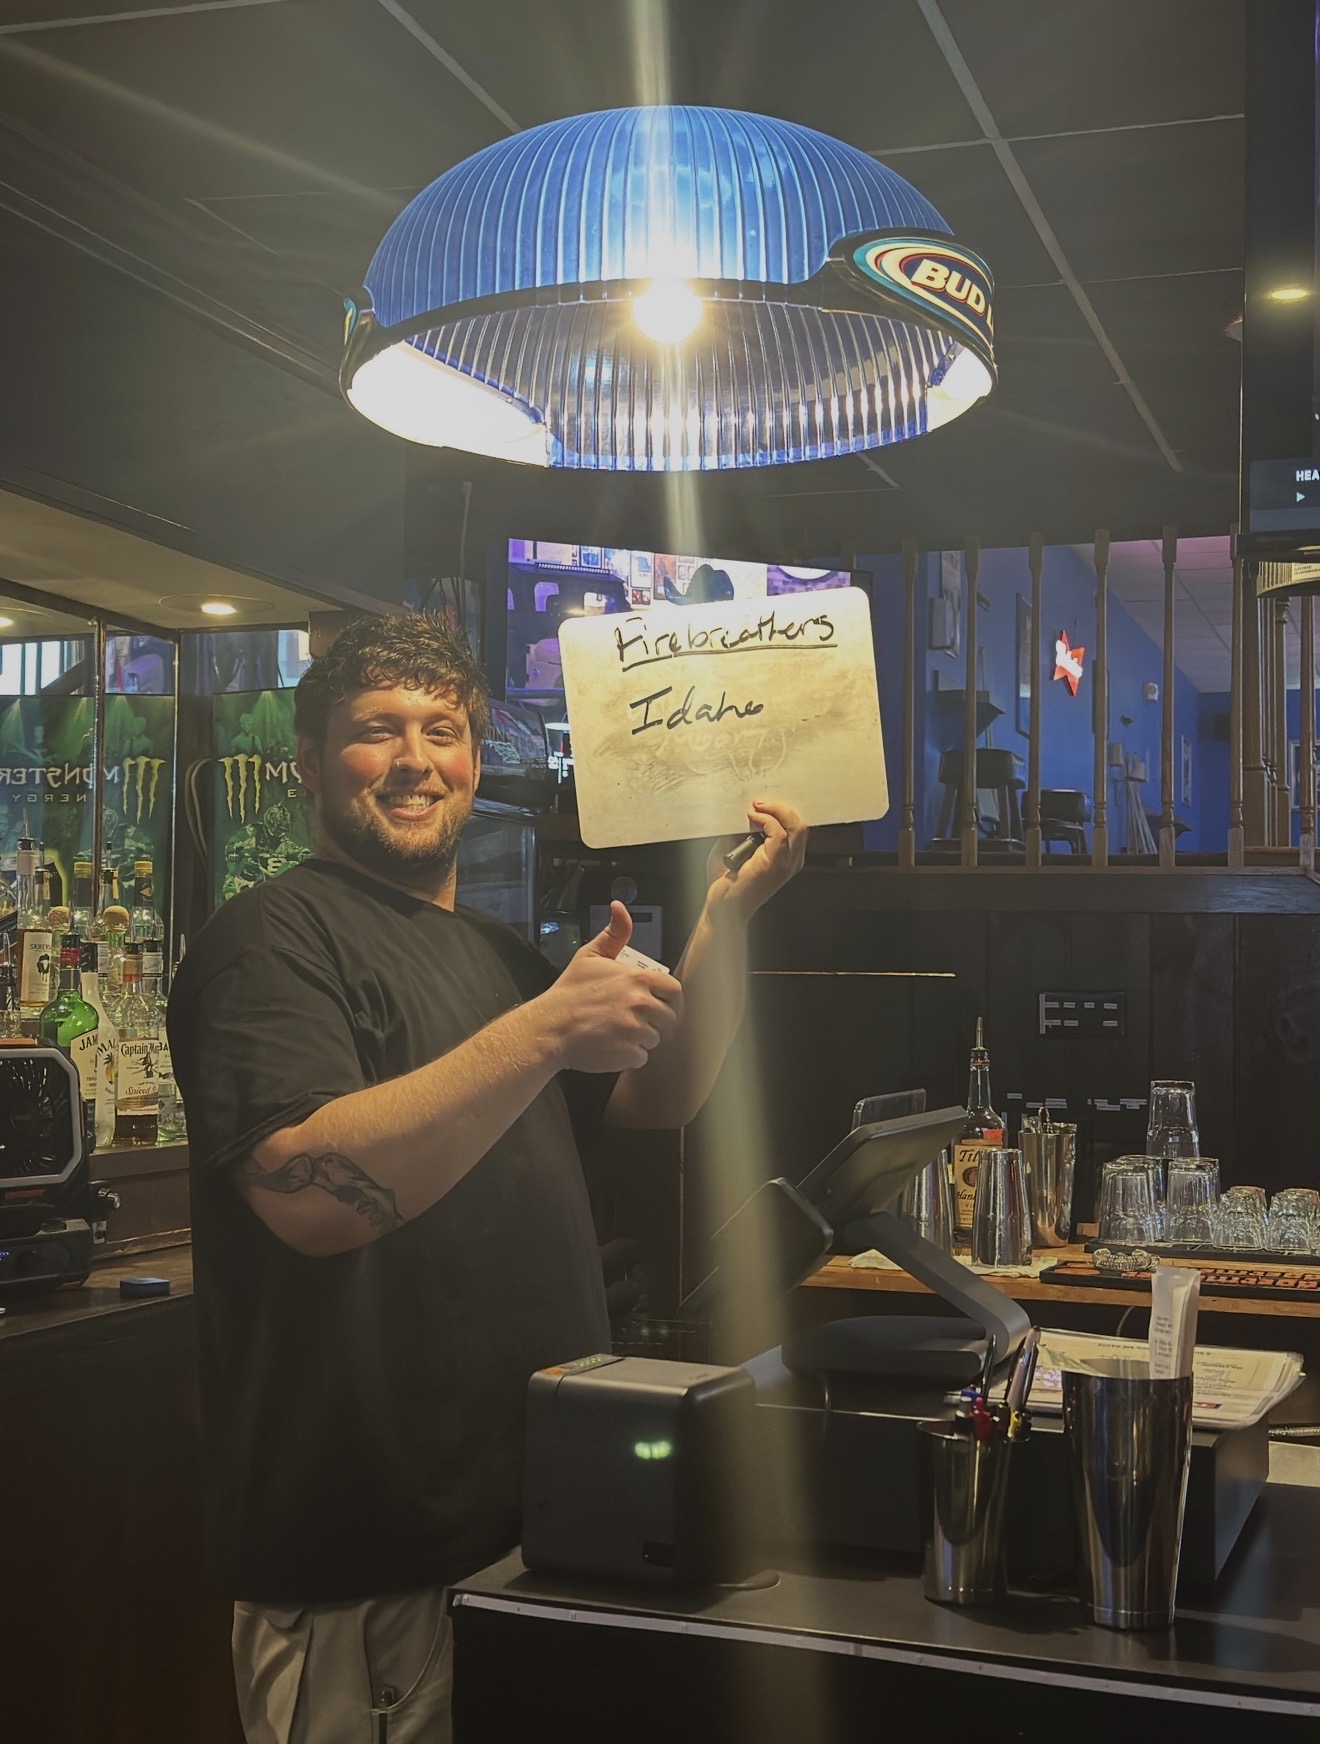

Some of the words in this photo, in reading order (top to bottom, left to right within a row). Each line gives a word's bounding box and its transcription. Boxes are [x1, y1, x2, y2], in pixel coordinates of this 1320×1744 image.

[911, 258, 986, 317] BUD
[1295, 469, 1320, 482] HEA
[613, 610, 835, 662] Firebreathers
[629, 685, 764, 735] Idaho
[121, 1042, 148, 1057] Captain
